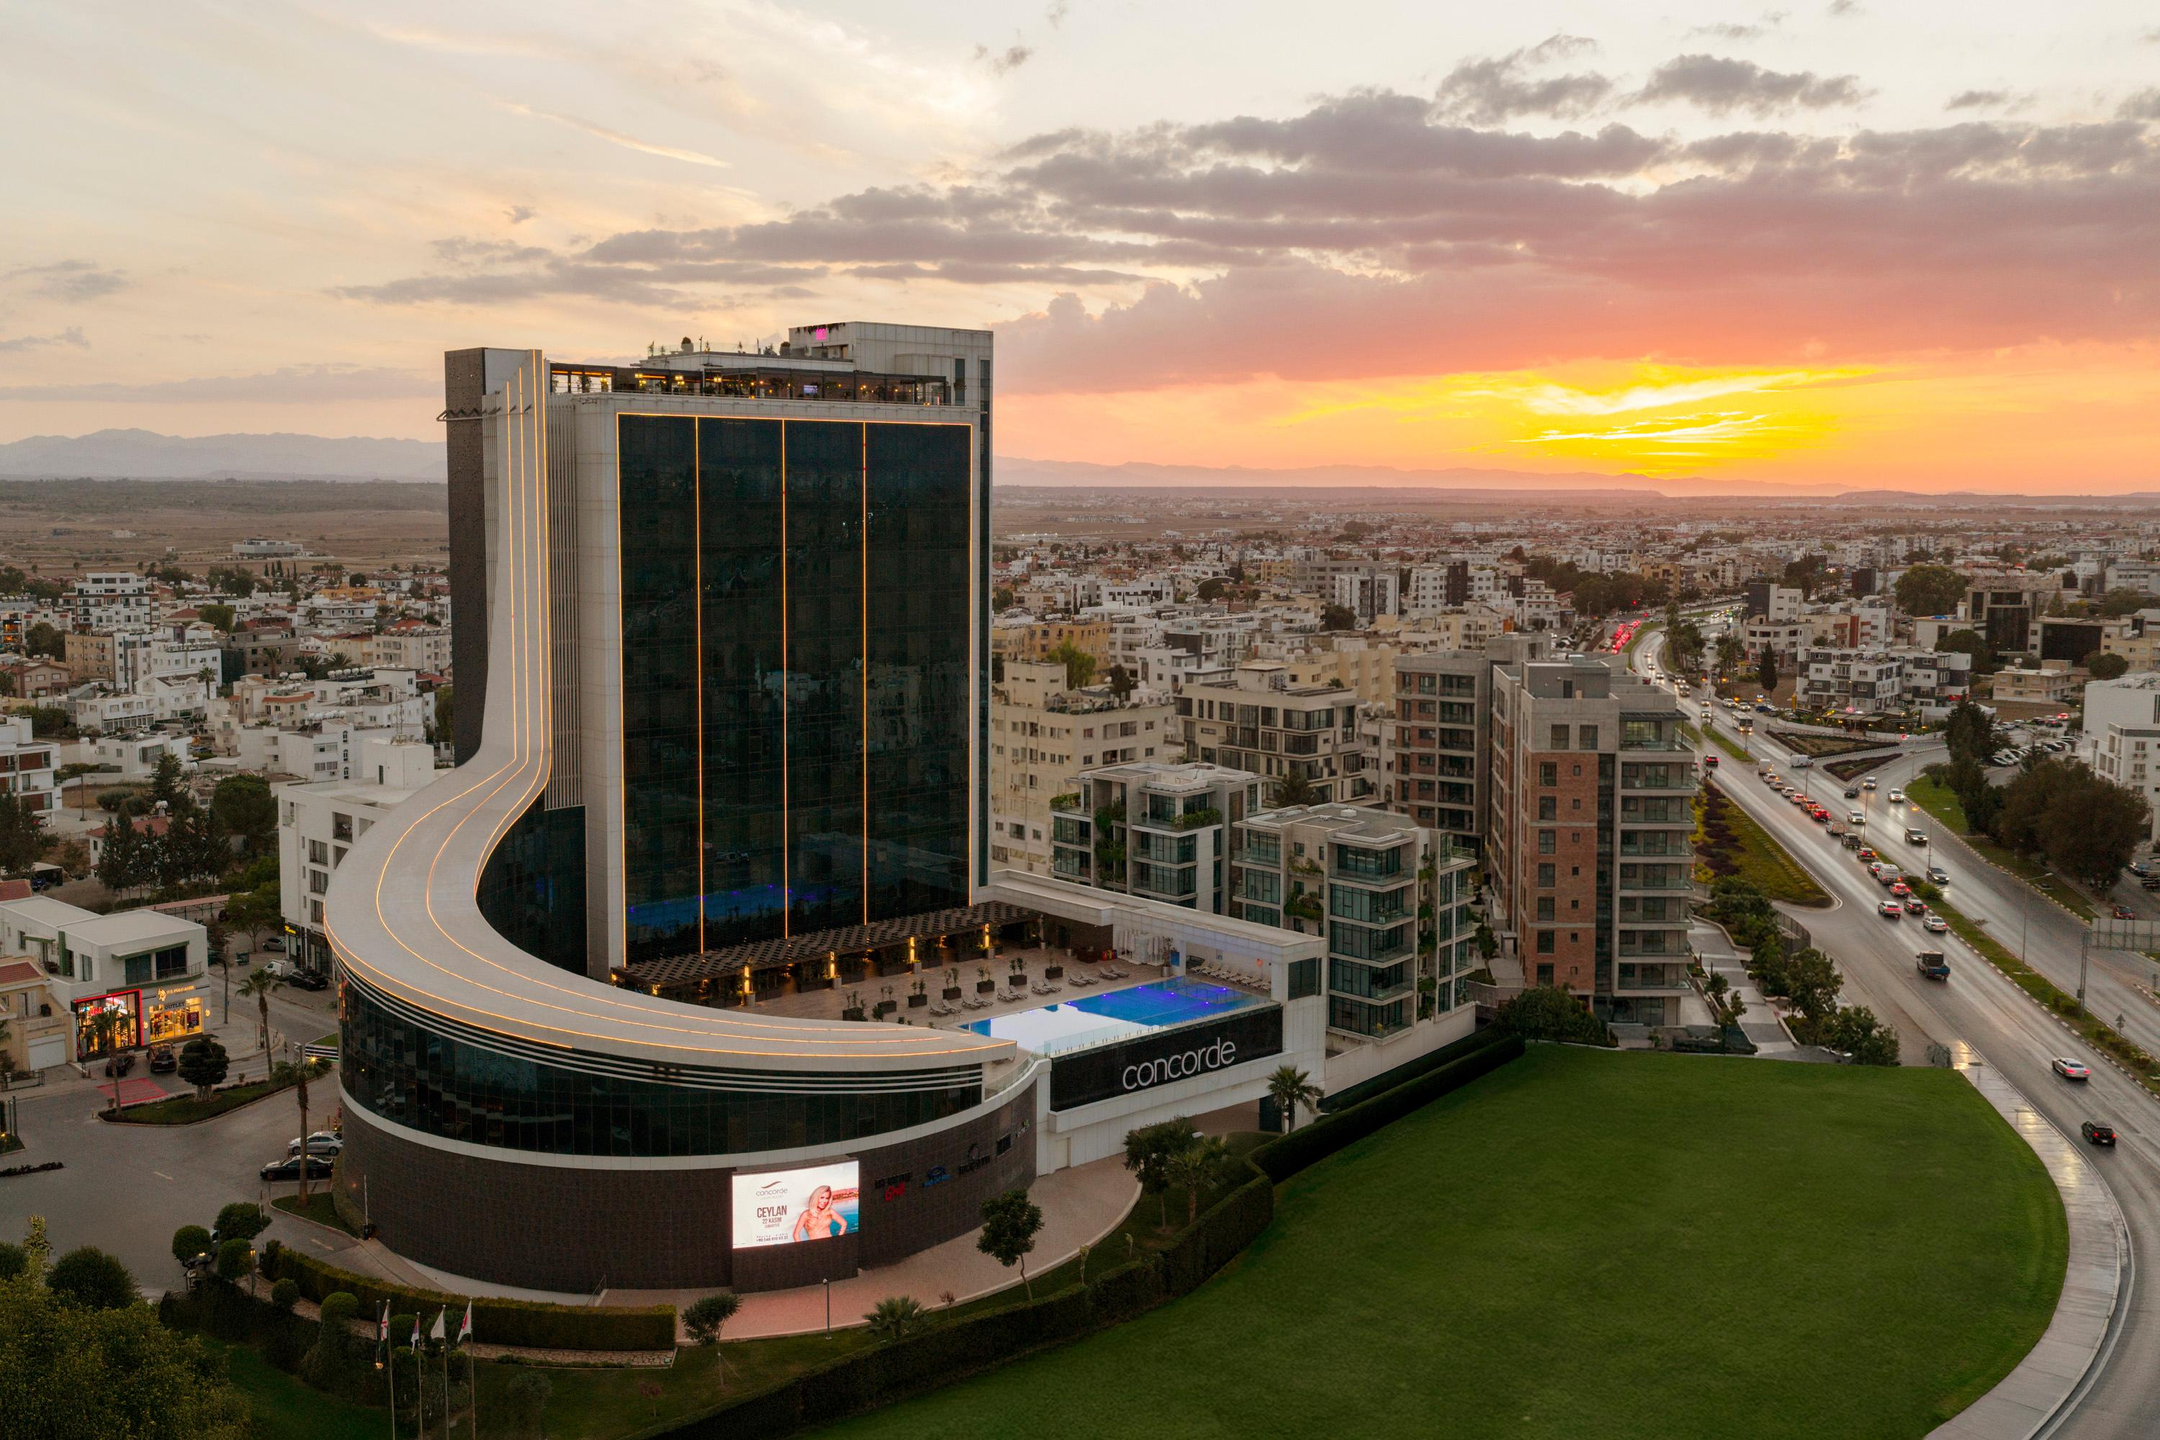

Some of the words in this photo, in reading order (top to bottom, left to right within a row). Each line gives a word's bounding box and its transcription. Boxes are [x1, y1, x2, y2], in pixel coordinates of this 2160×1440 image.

[1122, 1036, 1237, 1090] concorde
[755, 1188, 788, 1197] concorde
[756, 1205, 787, 1218] CEYLAN
